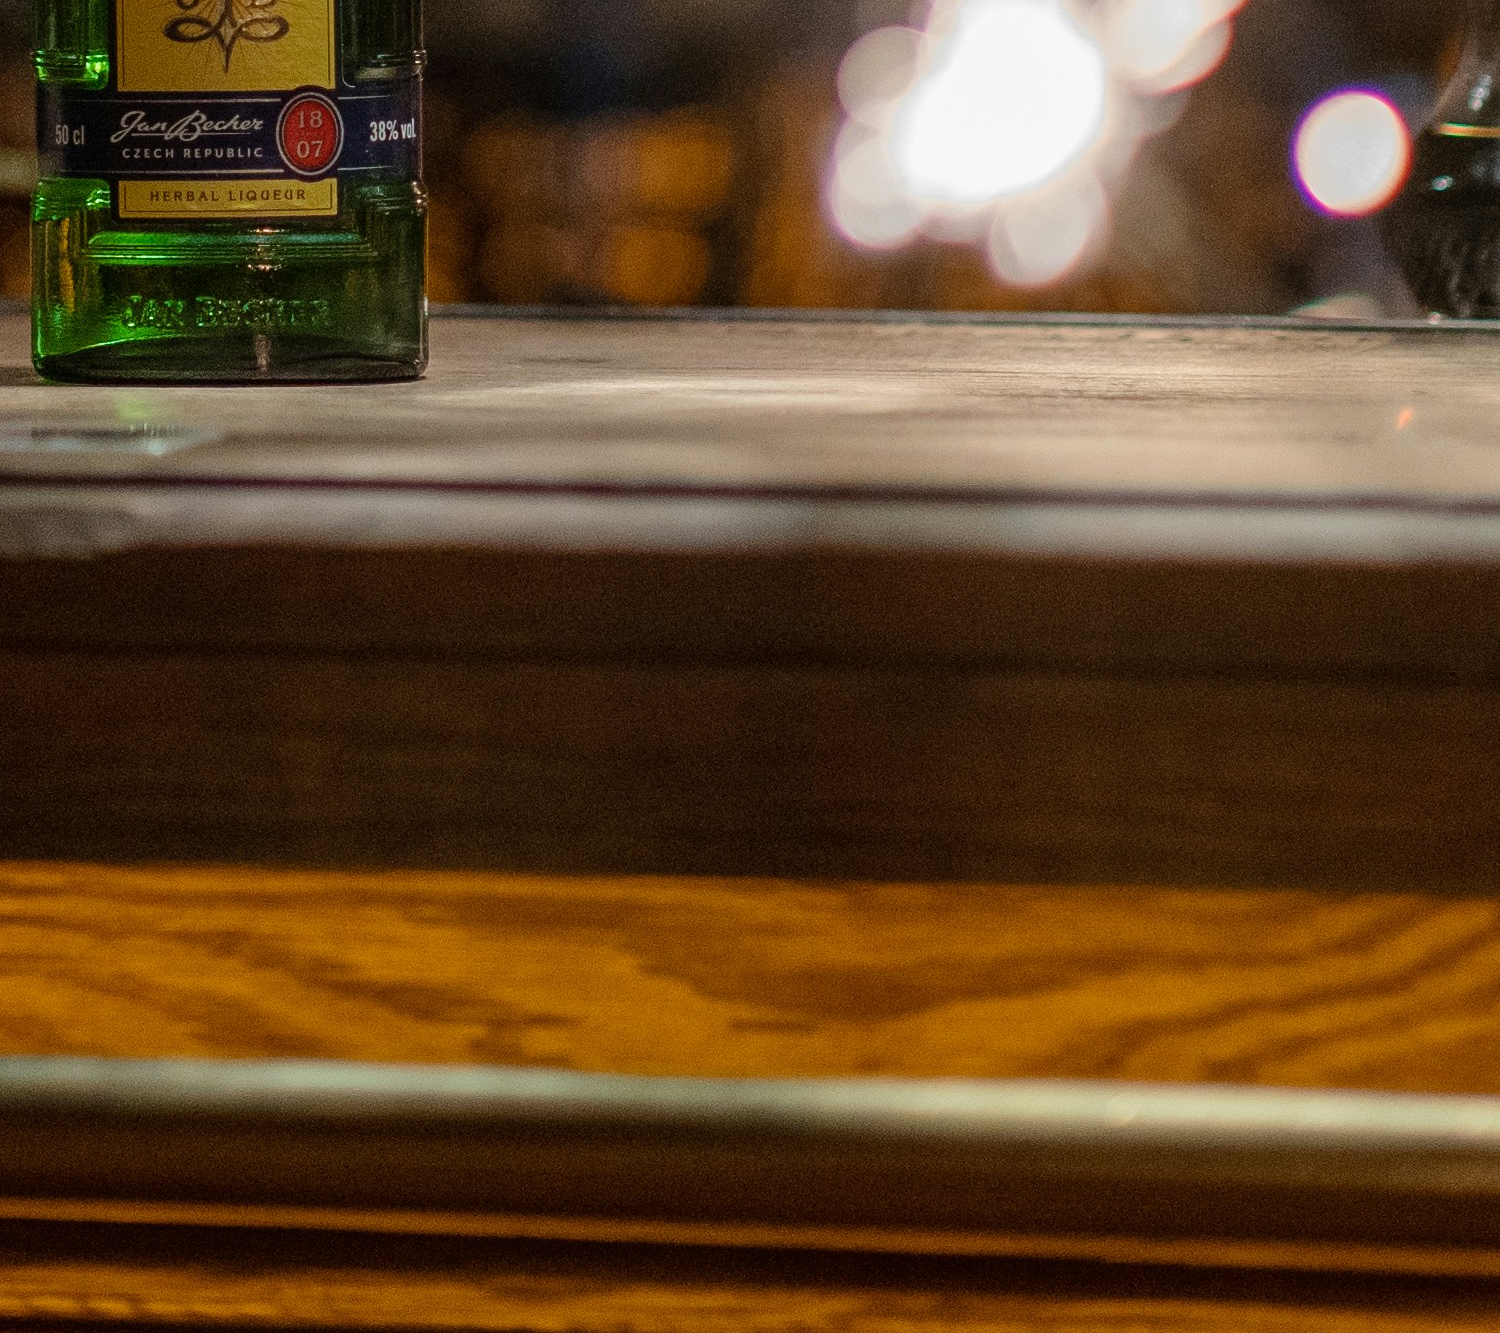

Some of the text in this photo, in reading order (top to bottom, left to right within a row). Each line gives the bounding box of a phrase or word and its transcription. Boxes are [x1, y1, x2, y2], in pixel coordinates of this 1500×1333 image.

[110, 109, 264, 143] Jan Becher
[298, 110, 323, 129] 18
[55, 124, 85, 145] 50 cl
[369, 119, 399, 142] 38%
[122, 147, 264, 159] CZECH REPUBLIC
[296, 140, 323, 159] 07
[149, 189, 307, 203] HERBAL LIQUEUR
